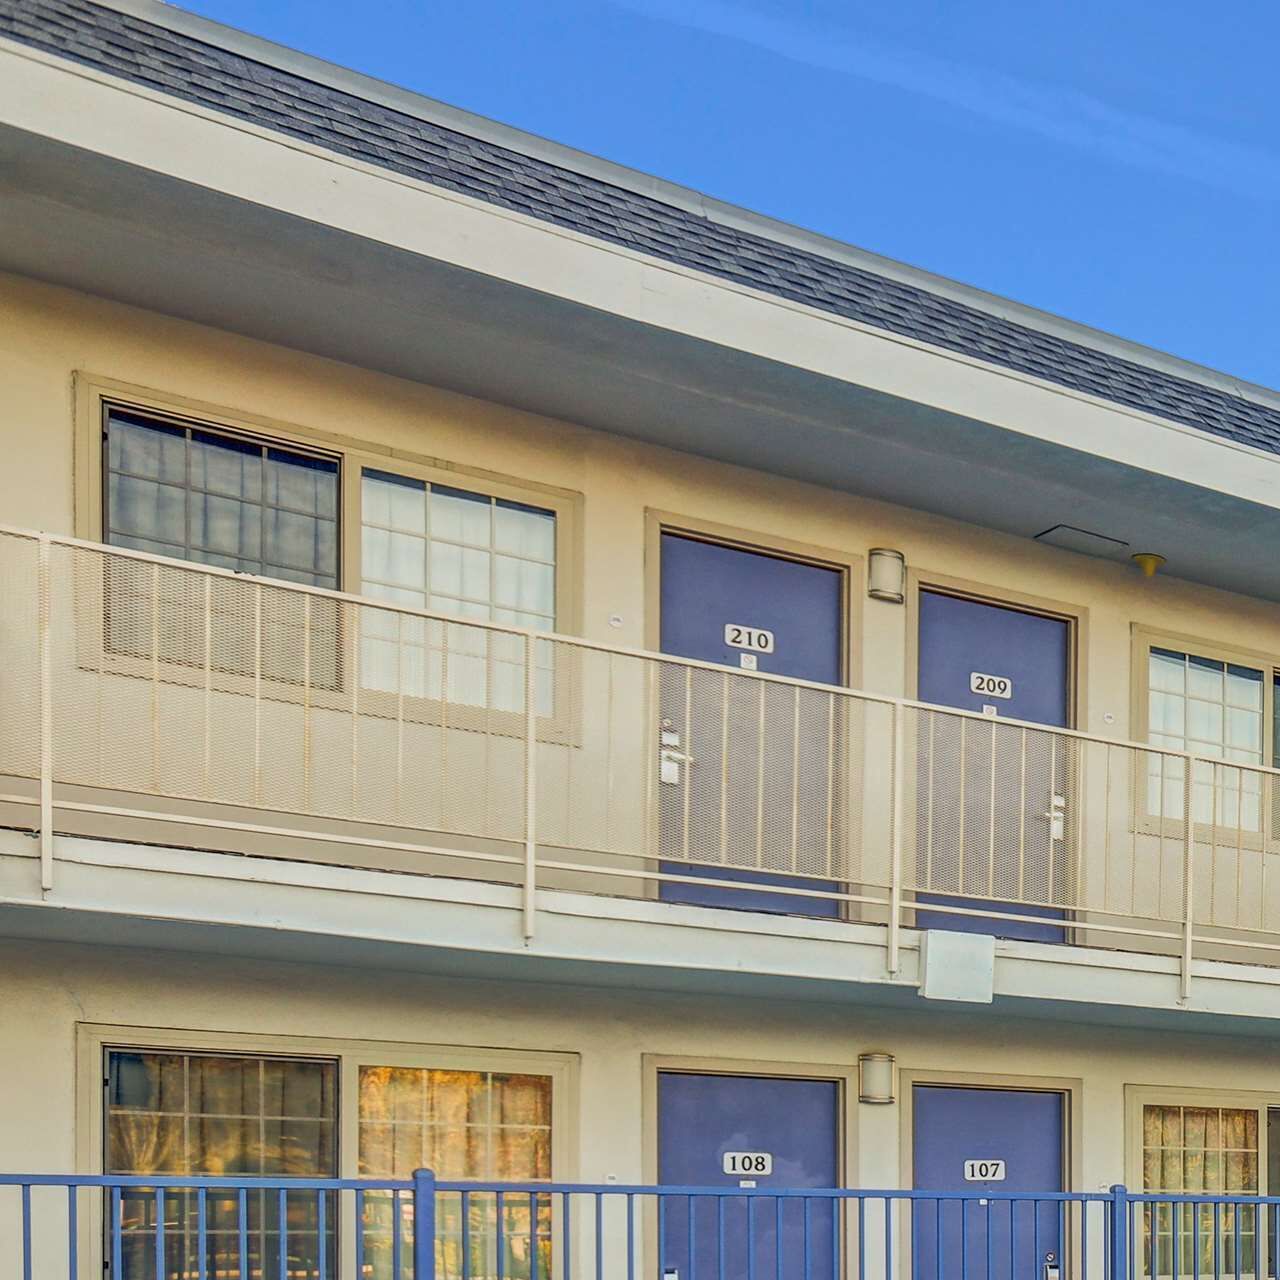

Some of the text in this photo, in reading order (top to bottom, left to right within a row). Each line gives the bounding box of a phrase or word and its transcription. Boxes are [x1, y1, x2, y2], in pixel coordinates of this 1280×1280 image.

[731, 628, 769, 649] 210
[975, 676, 1007, 694] 209
[730, 1155, 766, 1172] 108
[969, 1162, 1000, 1178] 107
